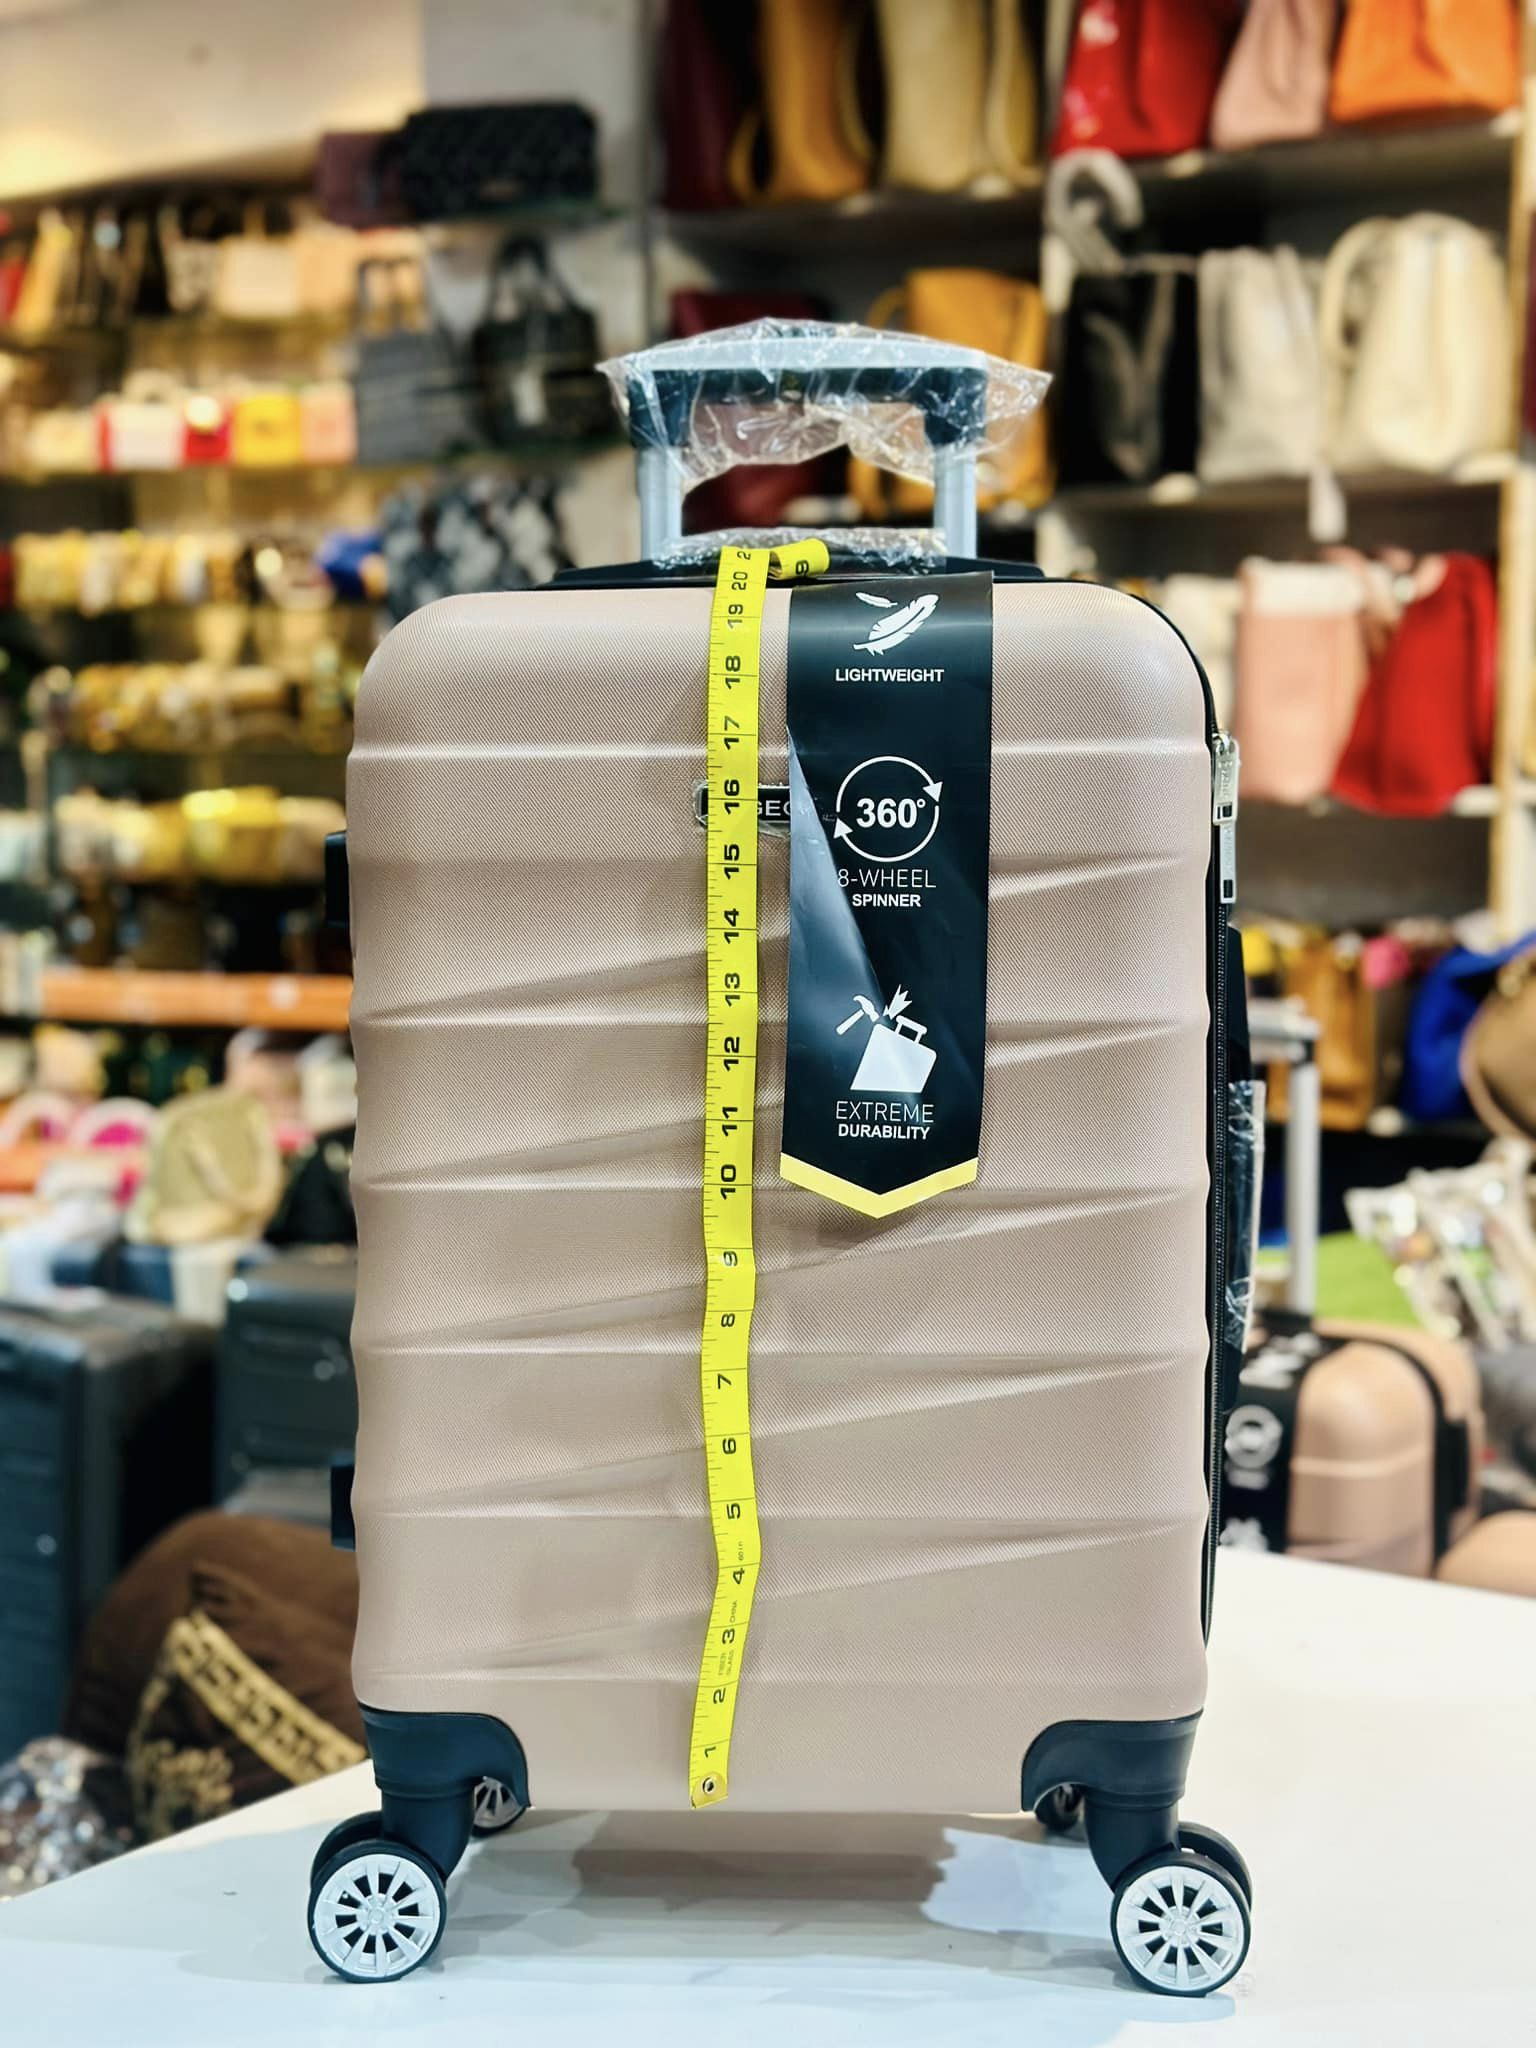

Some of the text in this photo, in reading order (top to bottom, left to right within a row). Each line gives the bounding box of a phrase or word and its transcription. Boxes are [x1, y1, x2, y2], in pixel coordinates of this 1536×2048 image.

[731, 571, 748, 590] 20
[727, 603, 743, 629] 19
[725, 655, 741, 690] 18
[835, 667, 945, 682] LIGHTWEIGHT
[724, 715, 740, 750] 17
[724, 779, 740, 815] 16
[856, 797, 927, 829] 360°
[724, 844, 740, 880] 15
[837, 868, 937, 888] 8-WHEEL
[852, 893, 922, 908] SPINNER
[724, 908, 740, 944] 14
[725, 972, 741, 1007] 13
[723, 1036, 740, 1071] 12
[836, 1100, 935, 1123] EXTREME
[722, 1107, 738, 1137] 11
[838, 1123, 931, 1140] DURABILITY
[720, 1164, 737, 1200] 10
[723, 1250, 738, 1267] 9
[720, 1313, 736, 1327] 8
[717, 1373, 732, 1389] 7
[722, 1437, 737, 1455] 6
[726, 1502, 741, 1520] 5
[732, 1567, 745, 1585] 4
[729, 1600, 738, 1623] CHINA
[721, 1627, 736, 1645] 3
[713, 1687, 726, 1704] 2
[704, 1746, 717, 1758] 1
